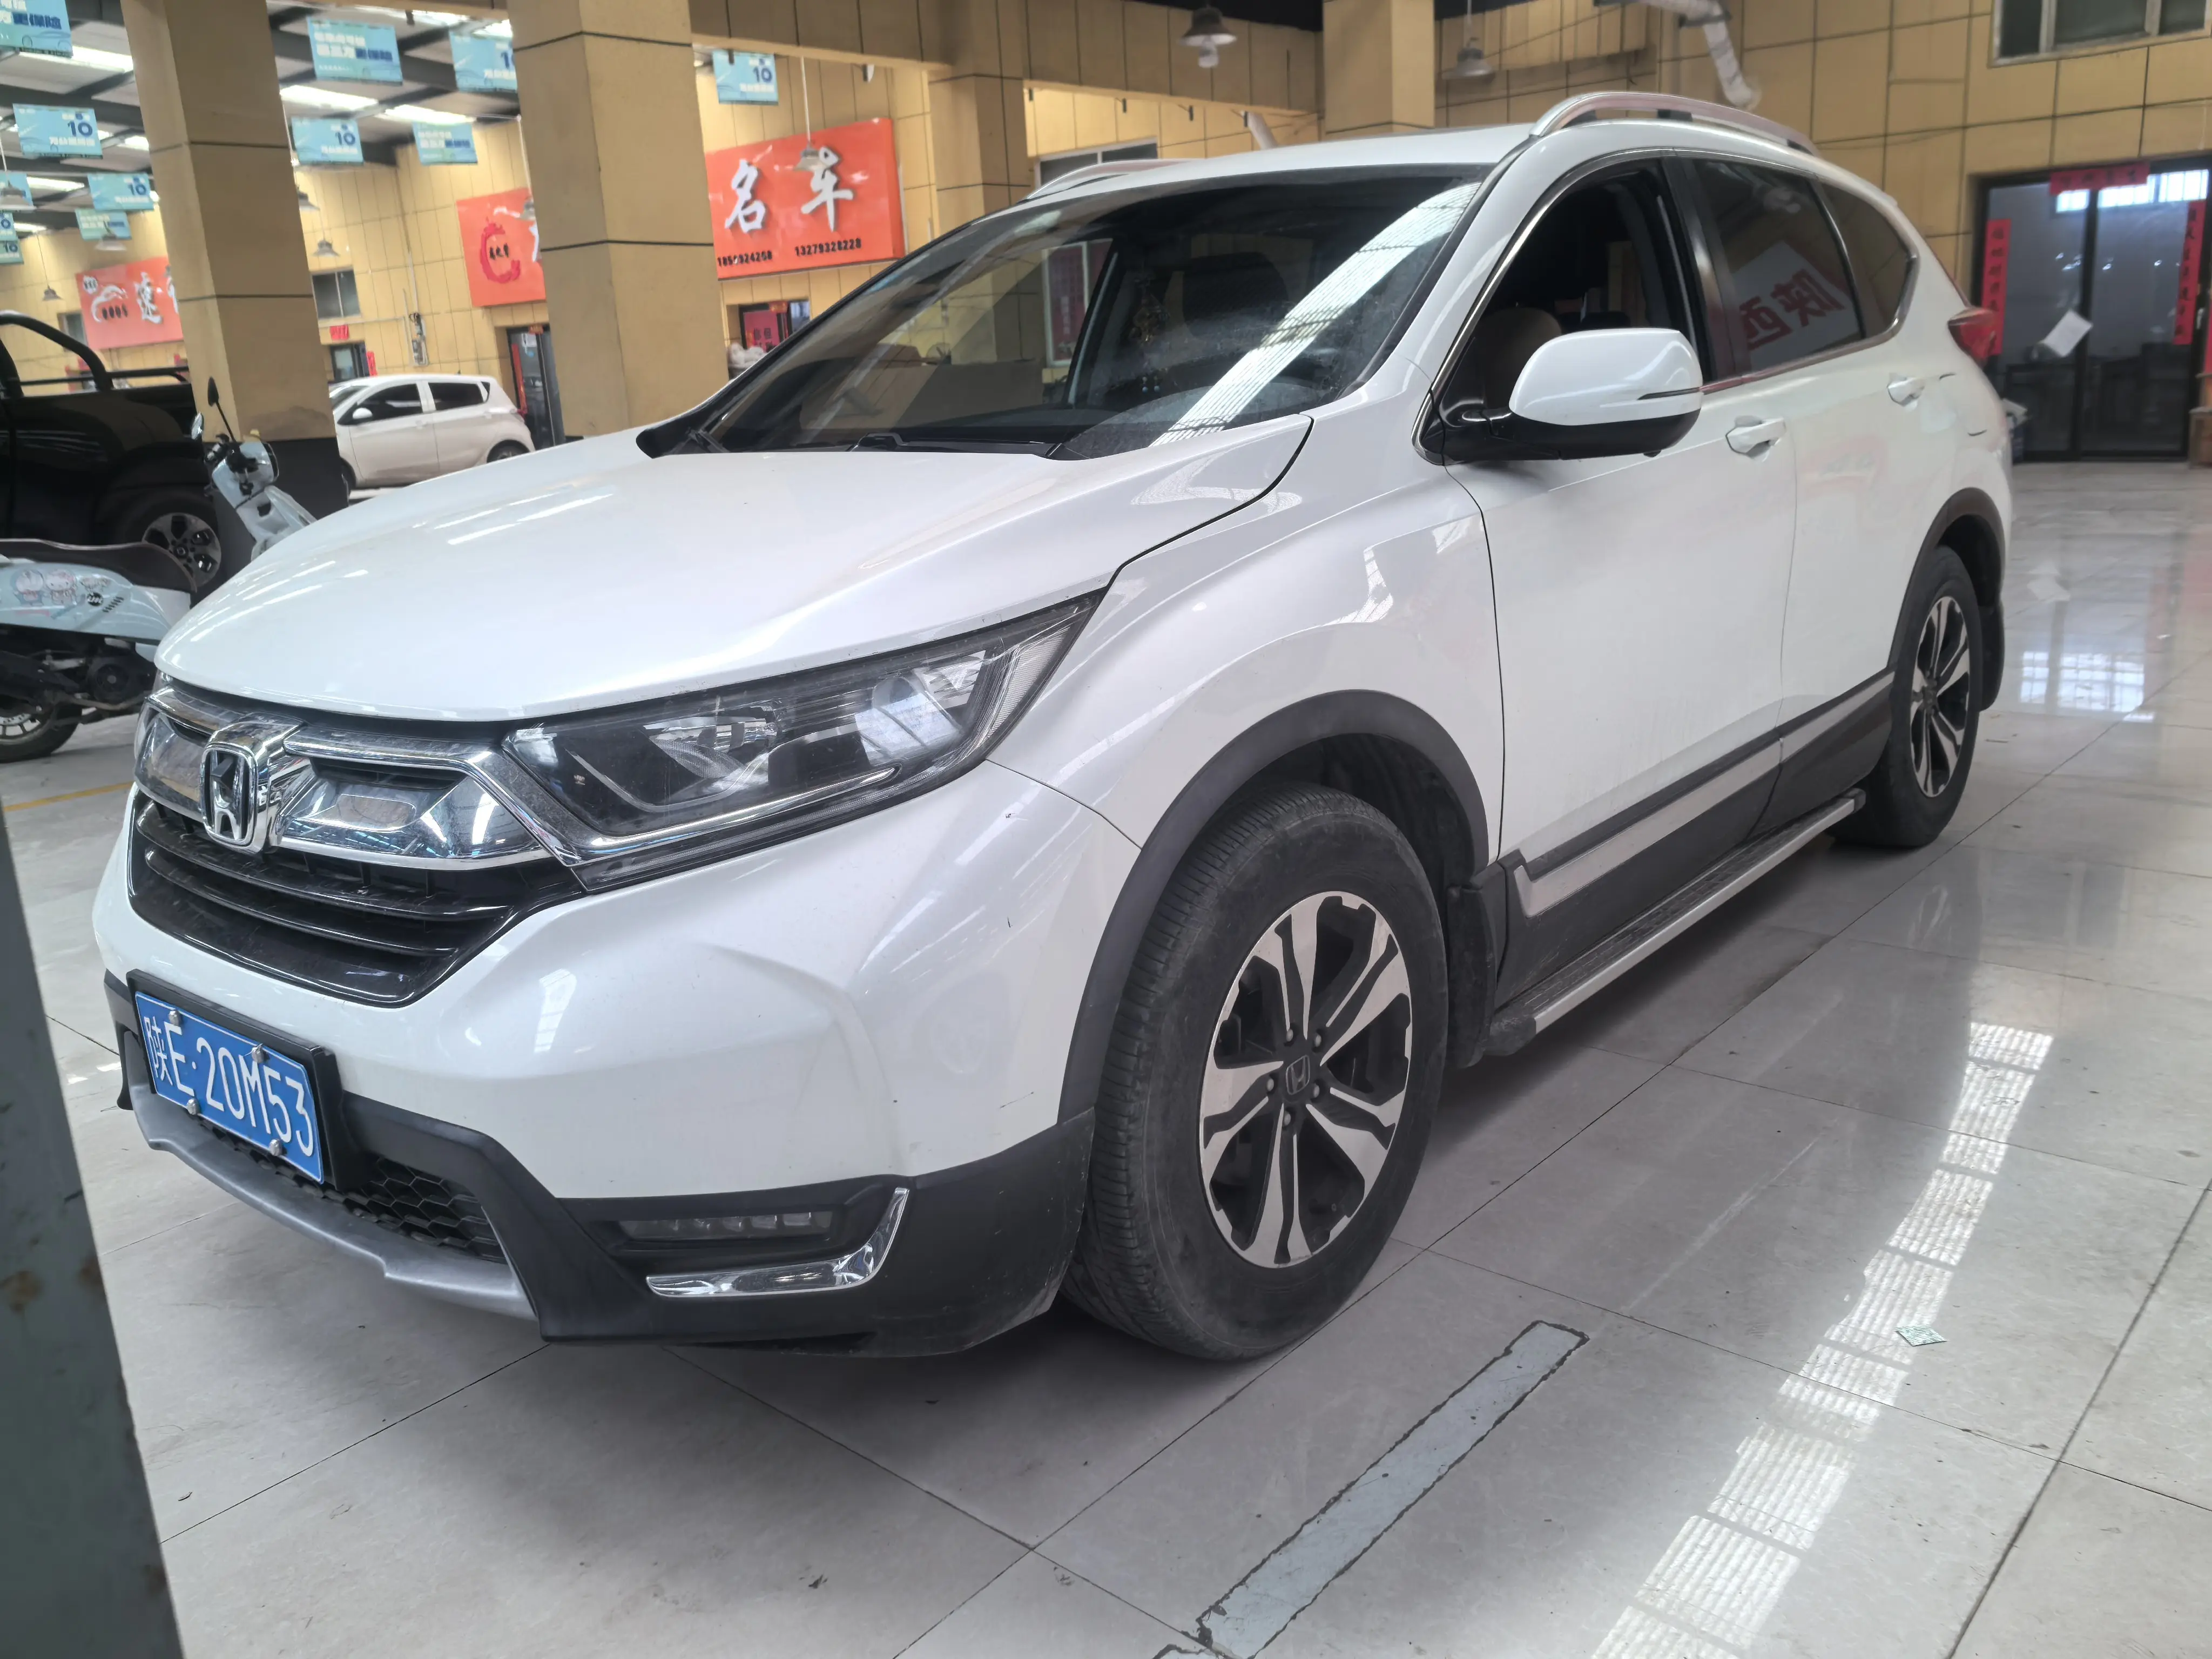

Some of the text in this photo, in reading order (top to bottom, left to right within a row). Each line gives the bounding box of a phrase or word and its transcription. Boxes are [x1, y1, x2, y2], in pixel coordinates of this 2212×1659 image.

[753, 66, 772, 83] 10
[68, 120, 93, 137] 10
[335, 132, 355, 146] 10
[128, 184, 146, 195] 10
